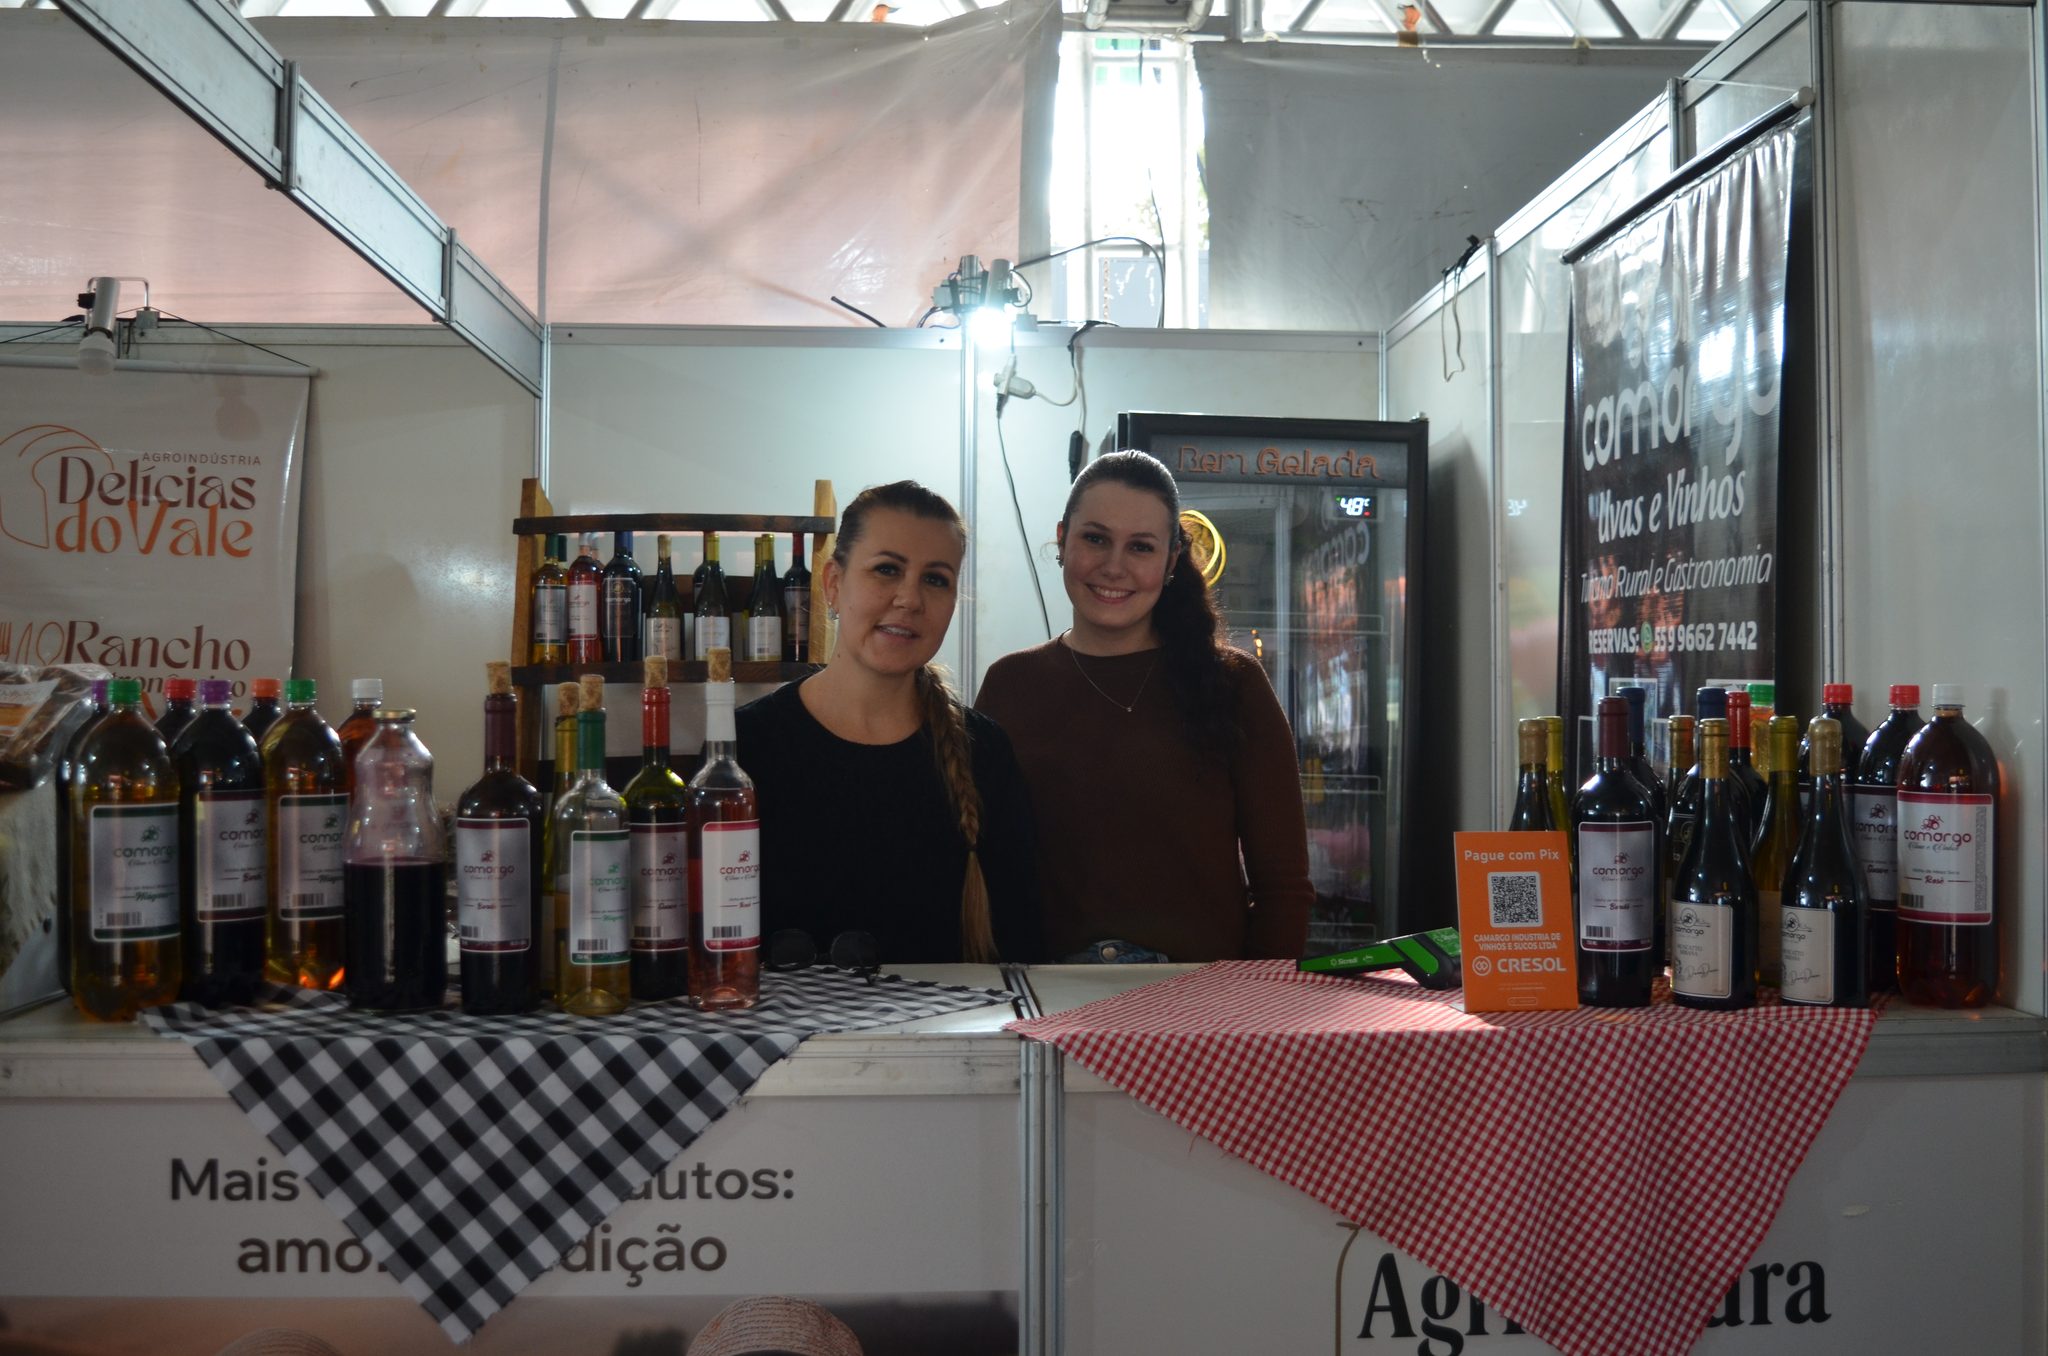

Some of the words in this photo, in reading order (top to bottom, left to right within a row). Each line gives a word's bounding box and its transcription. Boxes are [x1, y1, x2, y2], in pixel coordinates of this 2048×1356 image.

[142, 451, 262, 466] AGROINDÚSTRIA
[1254, 445, 1383, 479] Gelada
[58, 456, 257, 510] Delícias
[1648, 492, 1662, 533] e
[1667, 465, 1746, 530] Vinhos
[1615, 559, 1655, 598] Rural
[1652, 566, 1664, 594] e
[1663, 544, 1773, 593] Gastronomia
[63, 620, 250, 671] Rancho
[1588, 627, 1640, 655] RESERVAS:
[1718, 620, 1758, 651] 7442
[1904, 829, 1972, 847] camargo
[1464, 850, 1505, 864] Pague
[1508, 851, 1536, 861] com
[1539, 849, 1559, 860] Pix
[1592, 866, 1645, 878] camargo
[1473, 934, 1510, 942] CAMARGO
[1551, 932, 1561, 940] DE
[1478, 943, 1506, 951] VINHOS
[1514, 942, 1538, 950] SUCOS
[1539, 941, 1558, 950] LTDA
[1497, 957, 1567, 973] CRESOL
[171, 1156, 300, 1202] Mais
[237, 1237, 389, 1274] amo
[559, 1223, 728, 1288] dição
